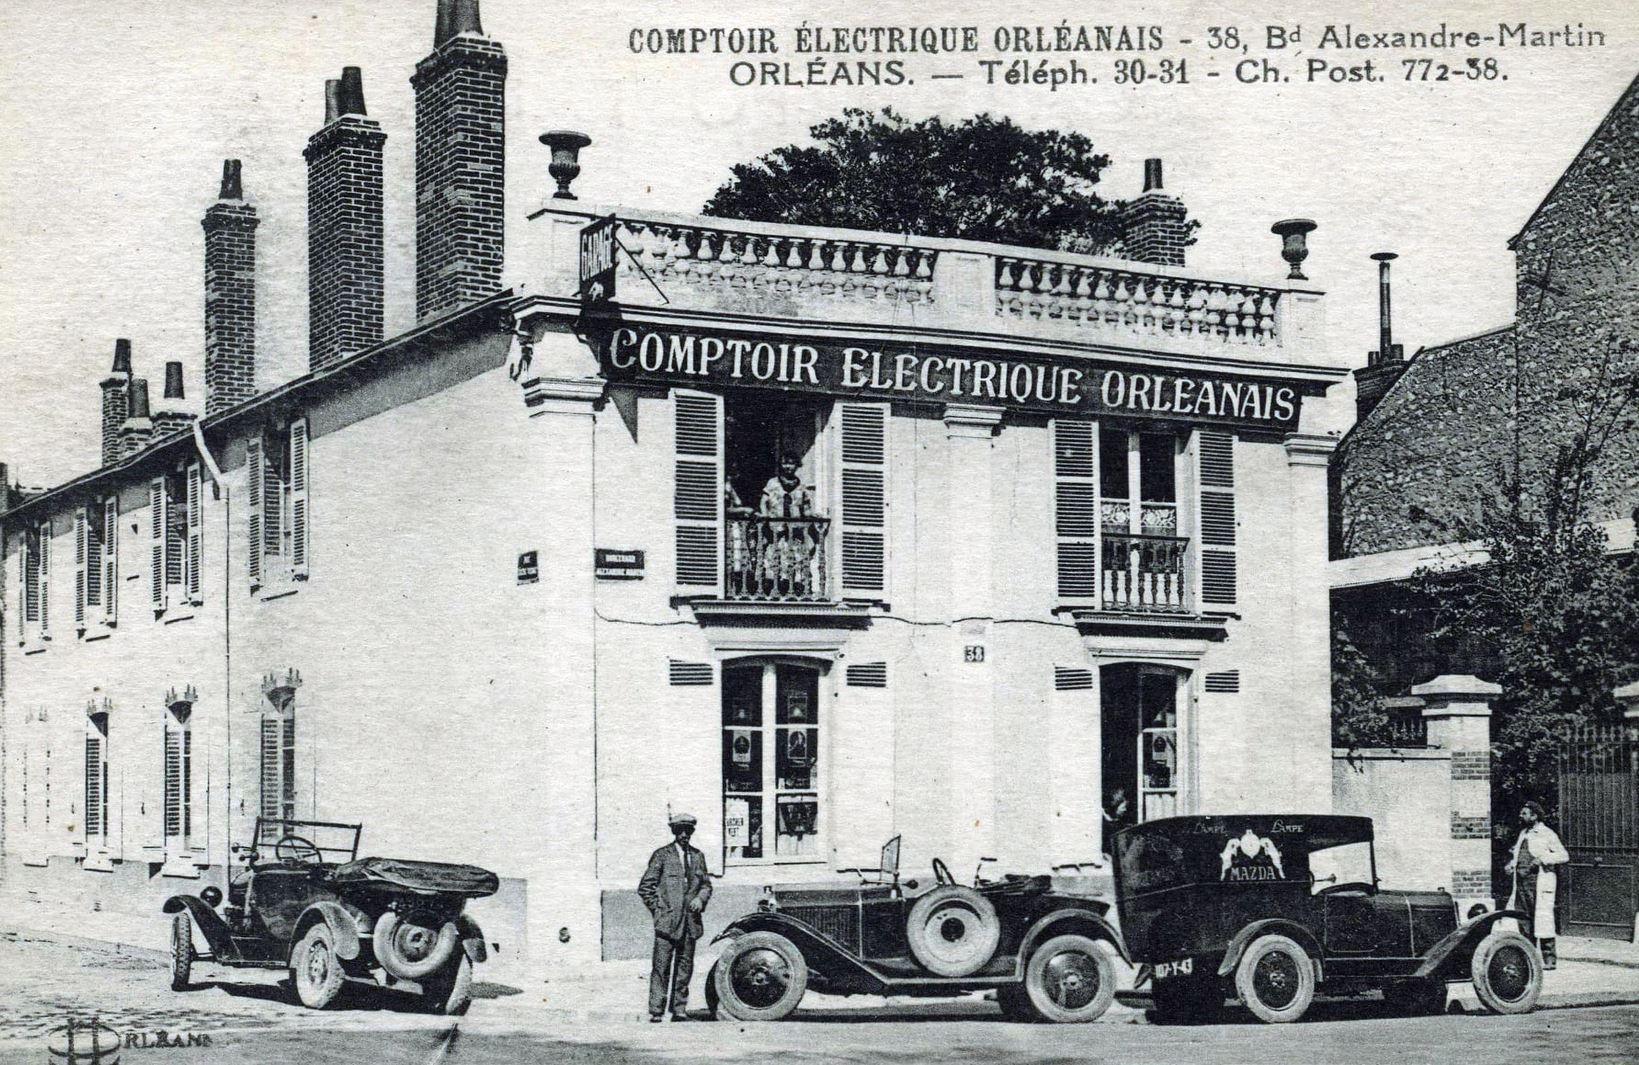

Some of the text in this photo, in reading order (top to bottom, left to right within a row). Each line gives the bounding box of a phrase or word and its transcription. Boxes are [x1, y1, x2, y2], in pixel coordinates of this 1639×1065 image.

[609, 327, 1295, 421] COMPTOIR ELECTRIQUE ORLEANAIS
[1230, 866, 1276, 881] MAZDA
